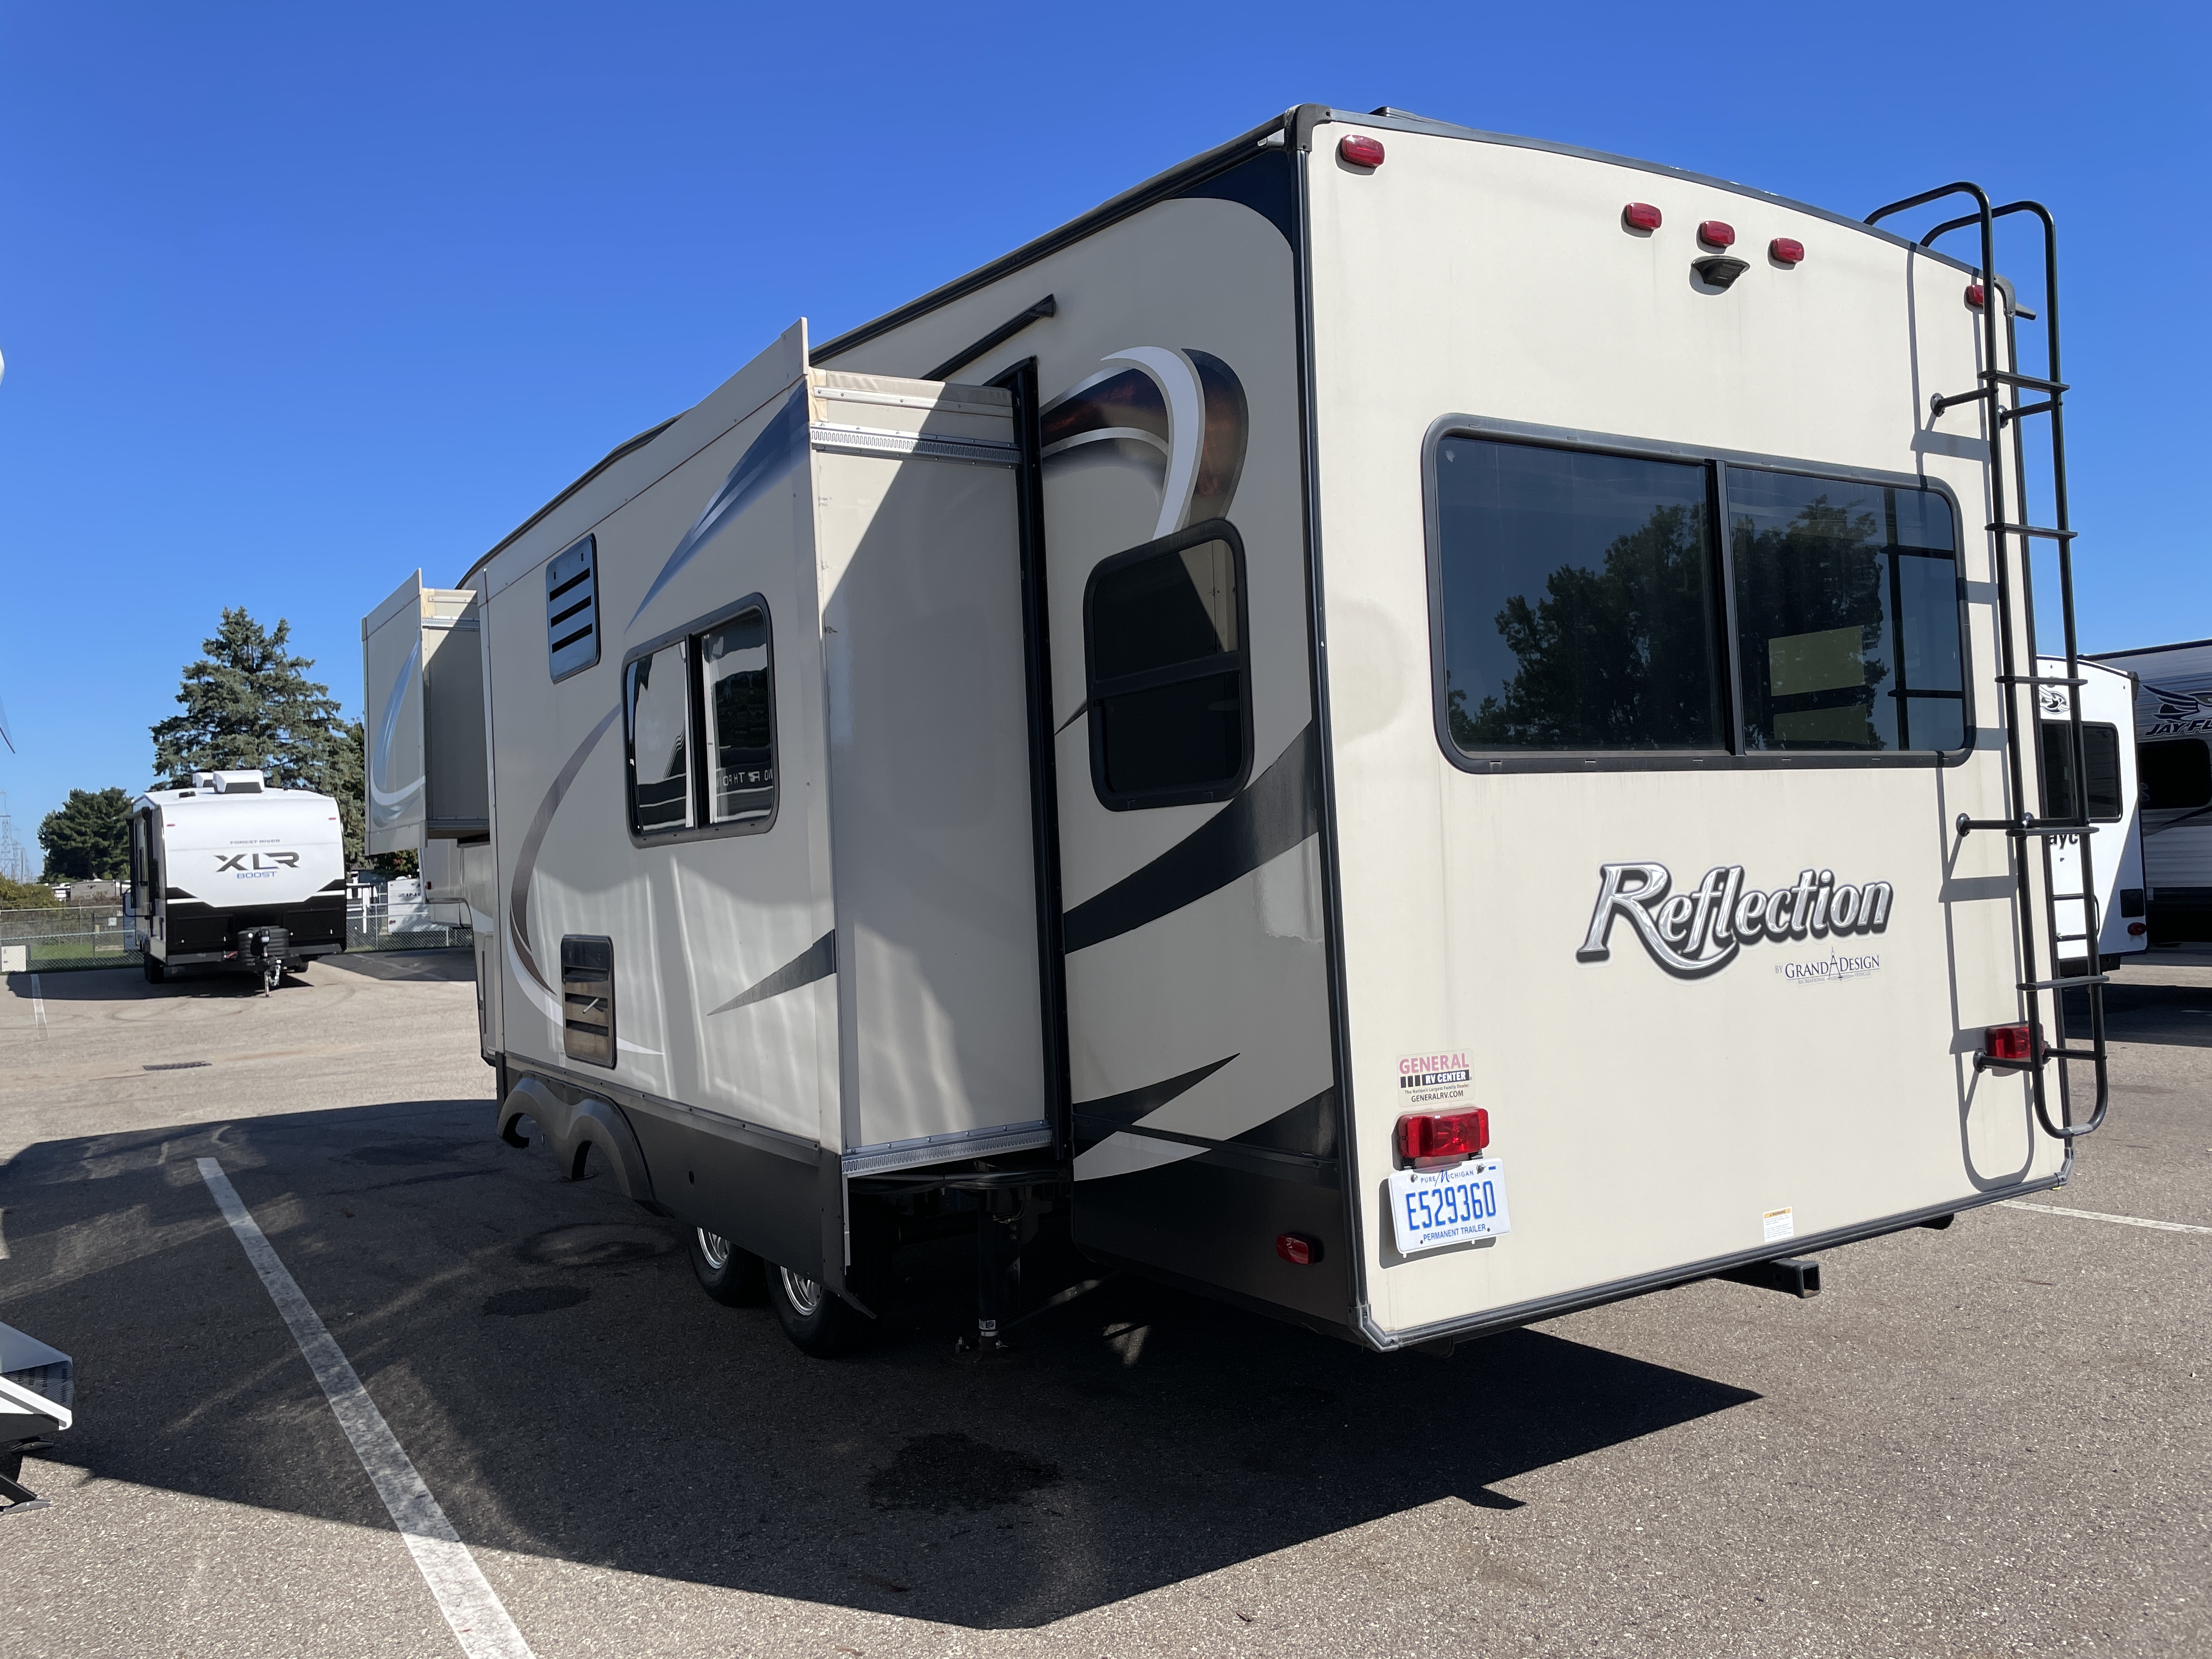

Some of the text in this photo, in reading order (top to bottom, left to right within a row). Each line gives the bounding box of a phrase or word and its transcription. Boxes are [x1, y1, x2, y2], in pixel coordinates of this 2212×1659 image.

[2145, 718, 2212, 736] JAY FL
[213, 851, 300, 873] XLR
[237, 871, 277, 879] BOOST
[1578, 864, 1893, 978] Reflection
[1775, 955, 1880, 978] BY GRAND DESIGN
[1400, 1053, 1469, 1074] GENERAL
[1425, 1071, 1466, 1084] RV CENTER
[1411, 1090, 1464, 1102] GENERALRV.COM
[1435, 1170, 1474, 1187] MICHIGAN
[1406, 1181, 1497, 1231] E529360
[1423, 1223, 1486, 1241] PERMANENT TRAILER
